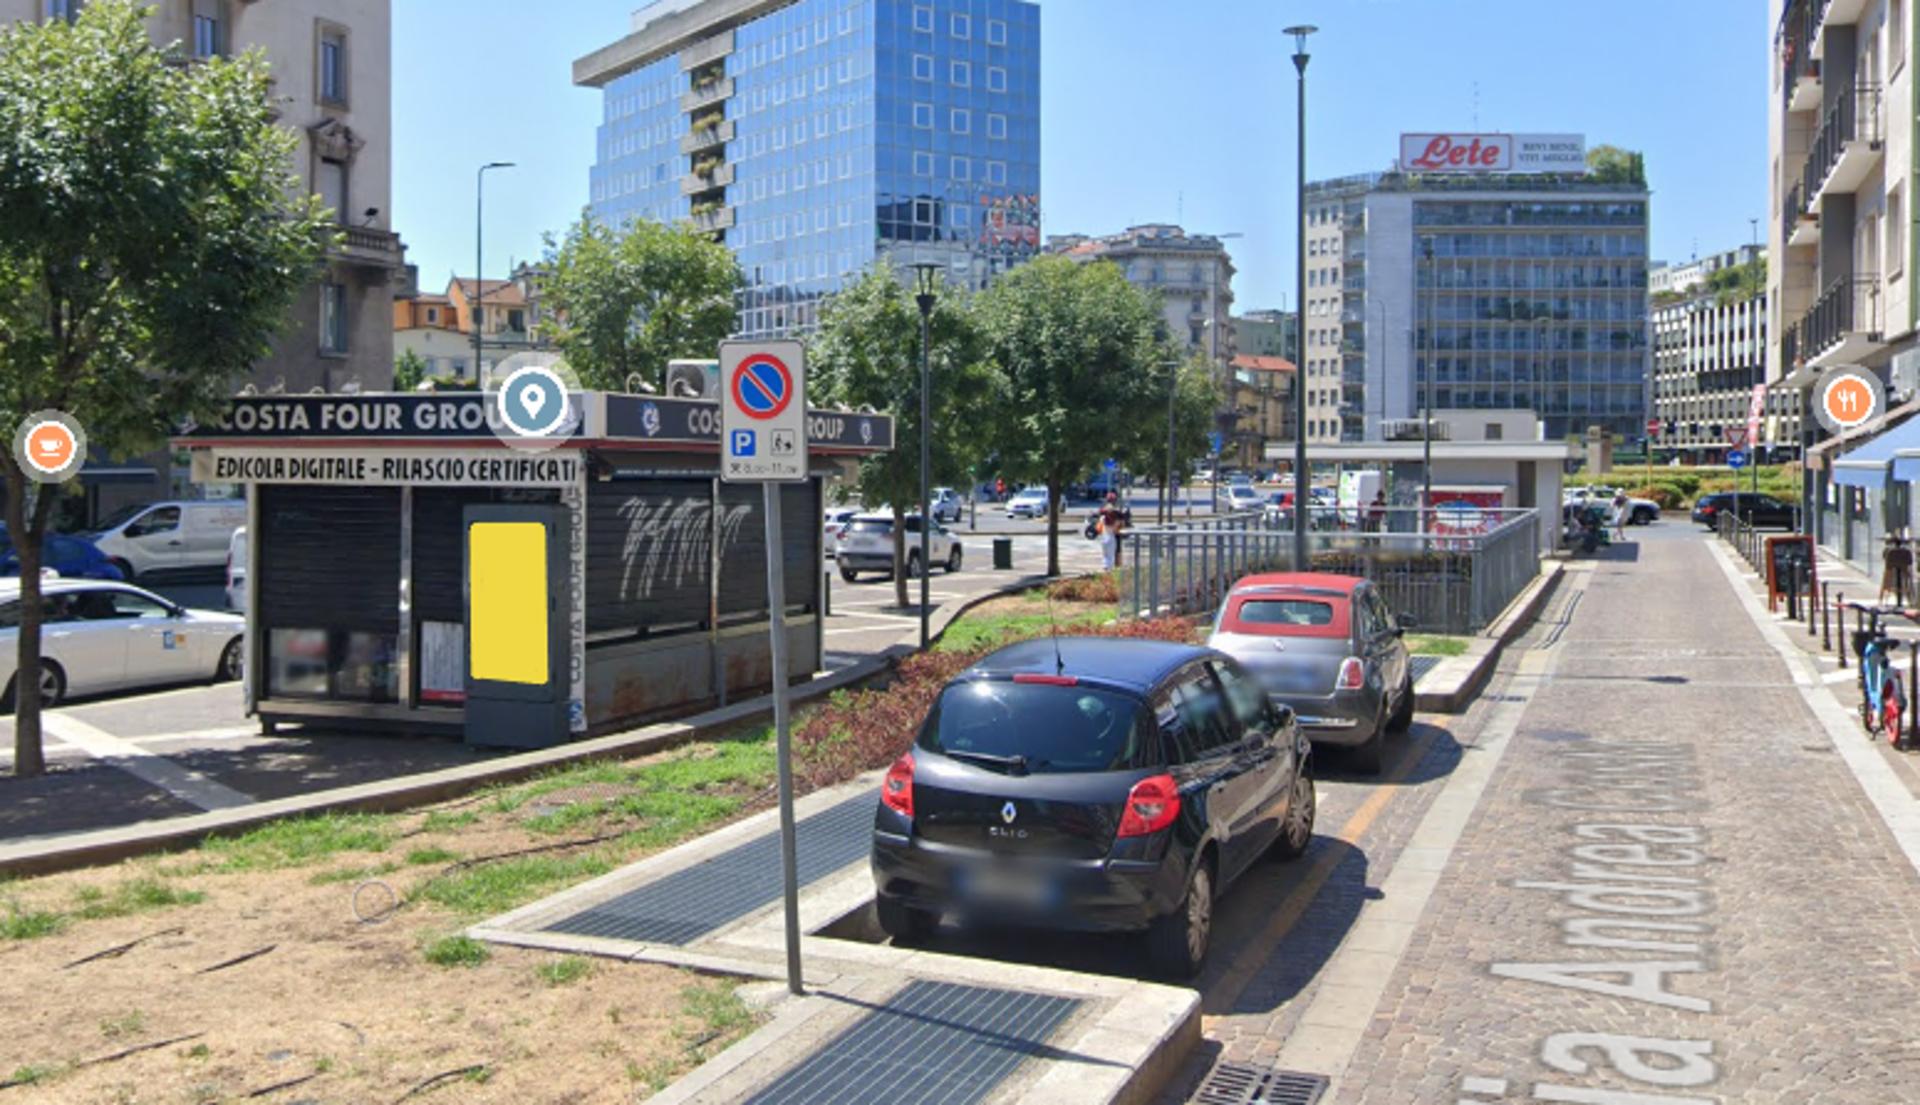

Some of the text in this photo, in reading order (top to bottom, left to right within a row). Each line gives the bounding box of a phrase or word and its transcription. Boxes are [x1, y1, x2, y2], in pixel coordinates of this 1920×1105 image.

[1411, 135, 1501, 170] Lete
[320, 402, 403, 430] FOUR
[216, 456, 285, 479] EDICOLA
[289, 457, 365, 480] DIGITALE
[383, 457, 464, 481] RILASCIO
[468, 457, 576, 482] CERTIFICATI
